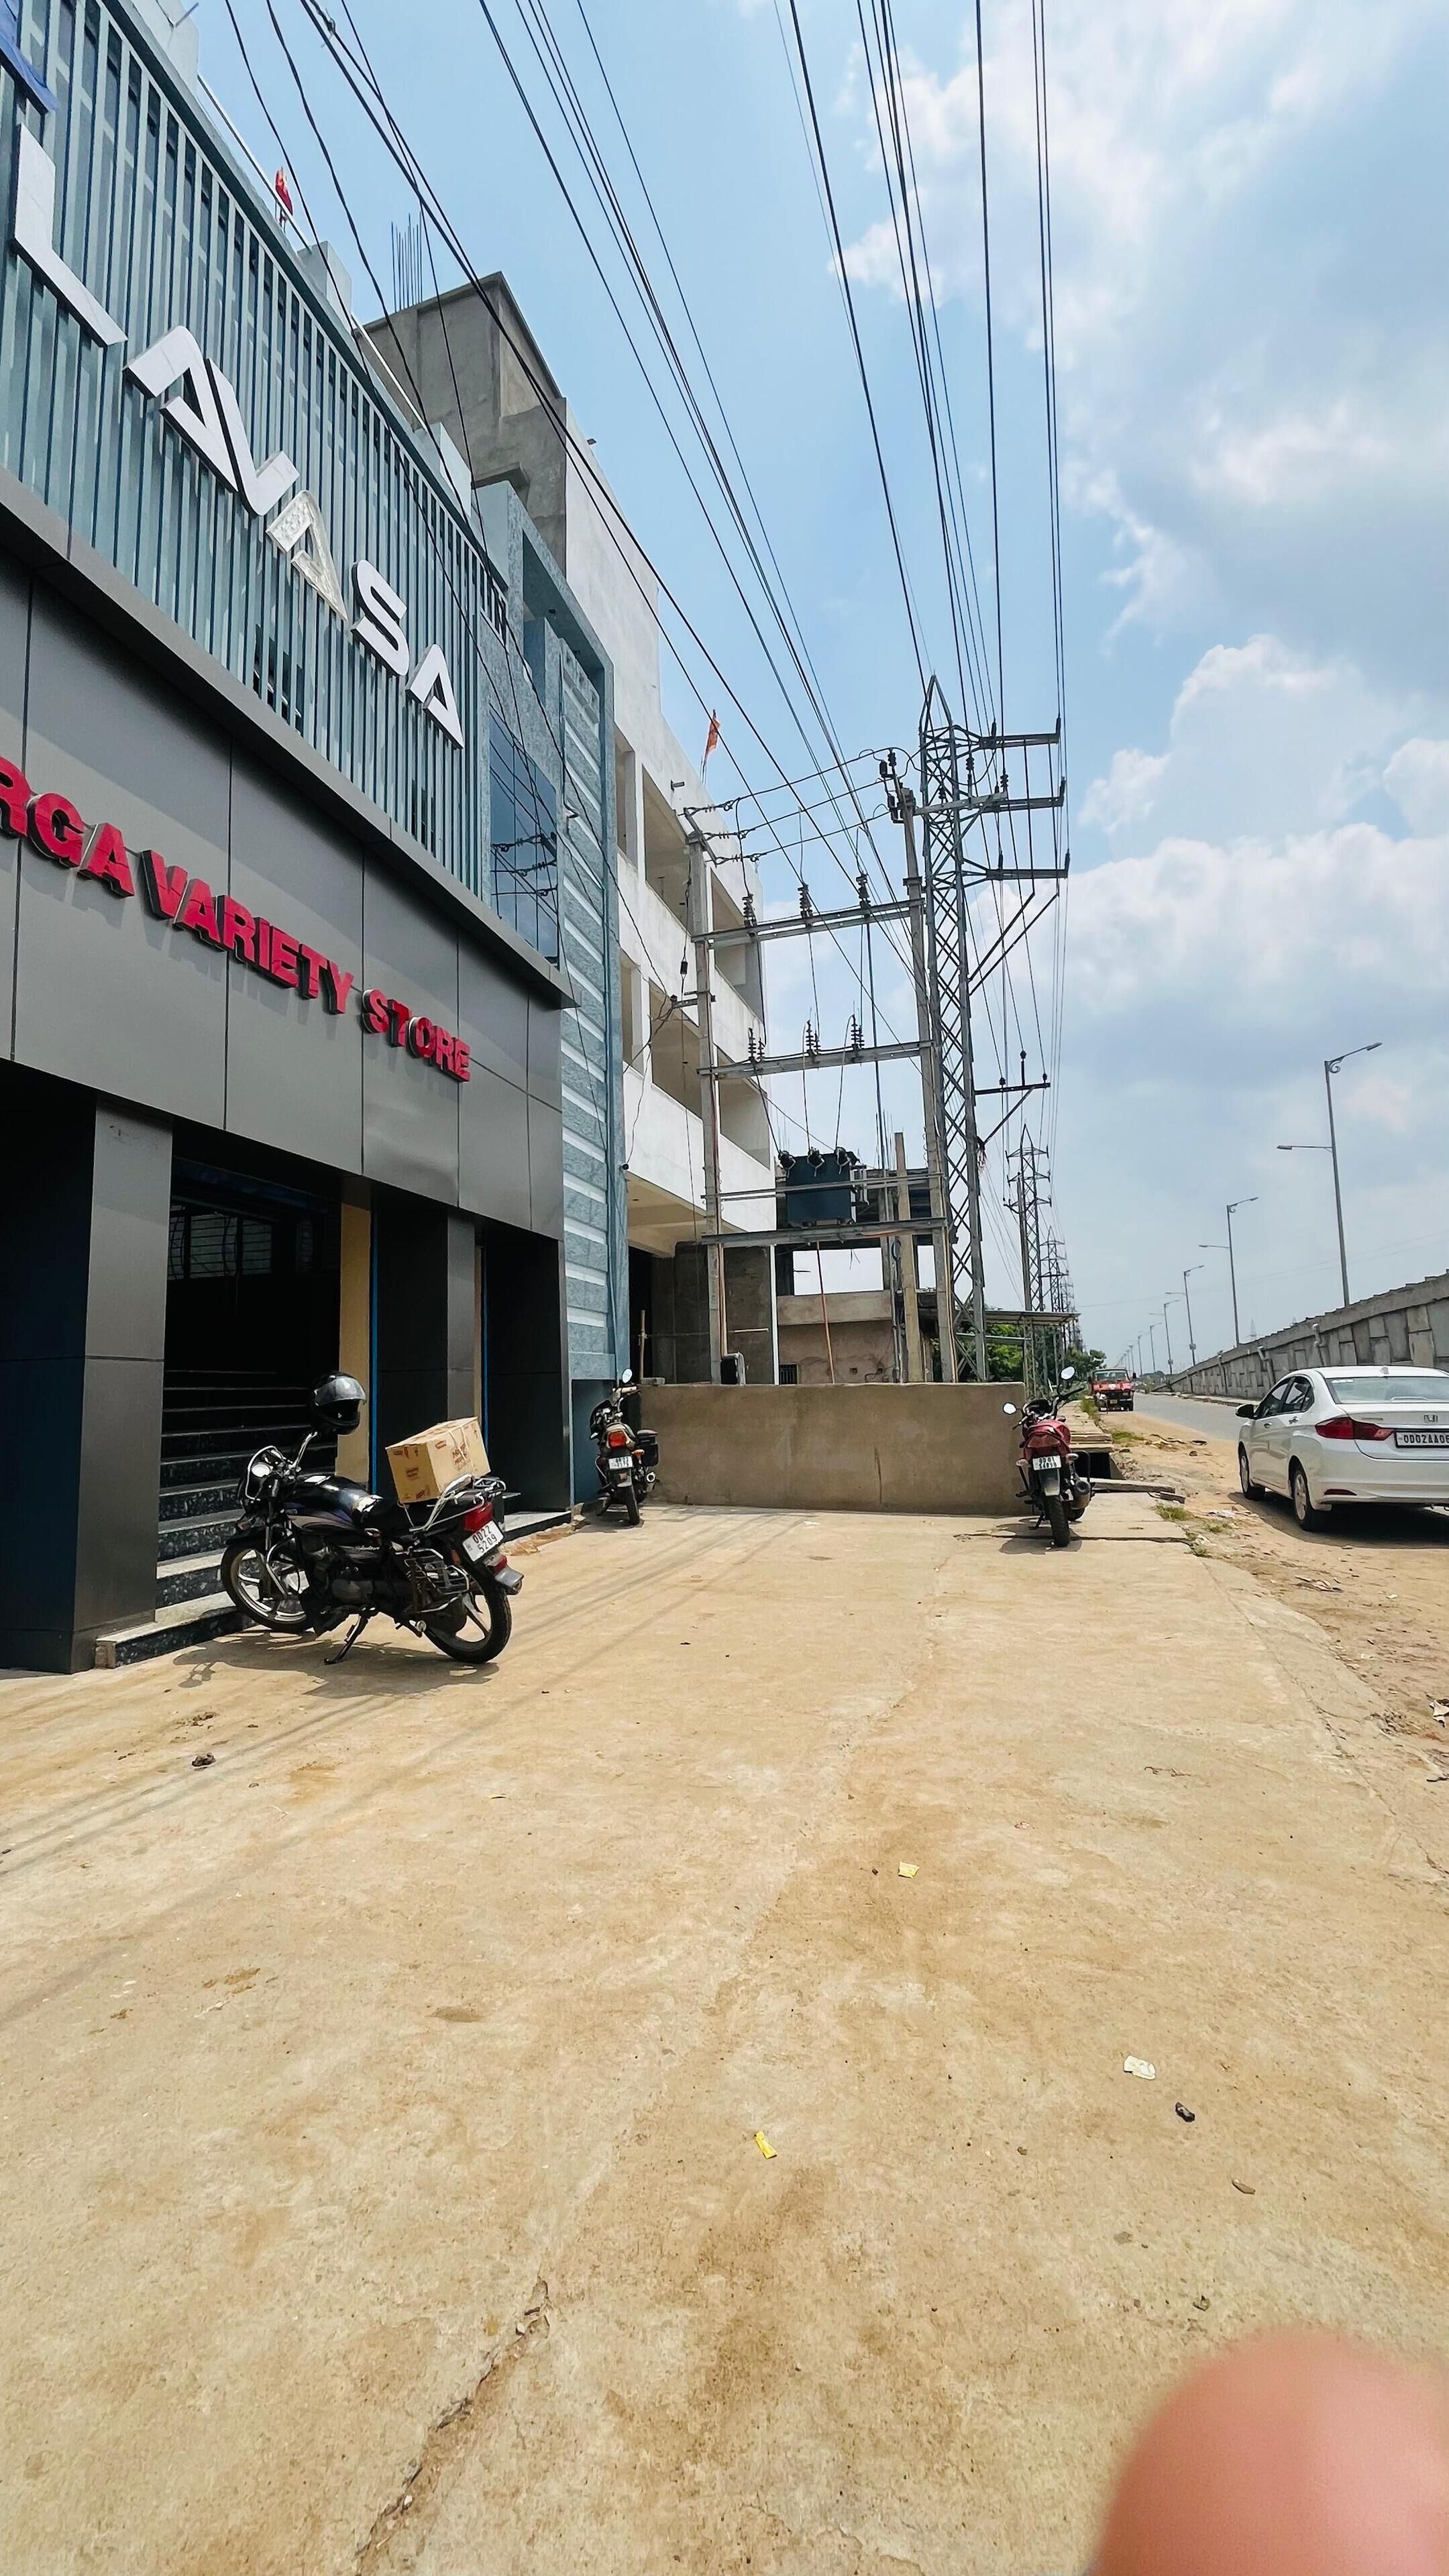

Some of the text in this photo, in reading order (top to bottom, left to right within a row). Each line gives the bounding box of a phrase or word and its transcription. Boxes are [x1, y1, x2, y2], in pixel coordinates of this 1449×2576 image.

[140, 849, 354, 1015] VARIETY
[361, 988, 470, 1082] STORE
[477, 1534, 497, 1553] 5209
